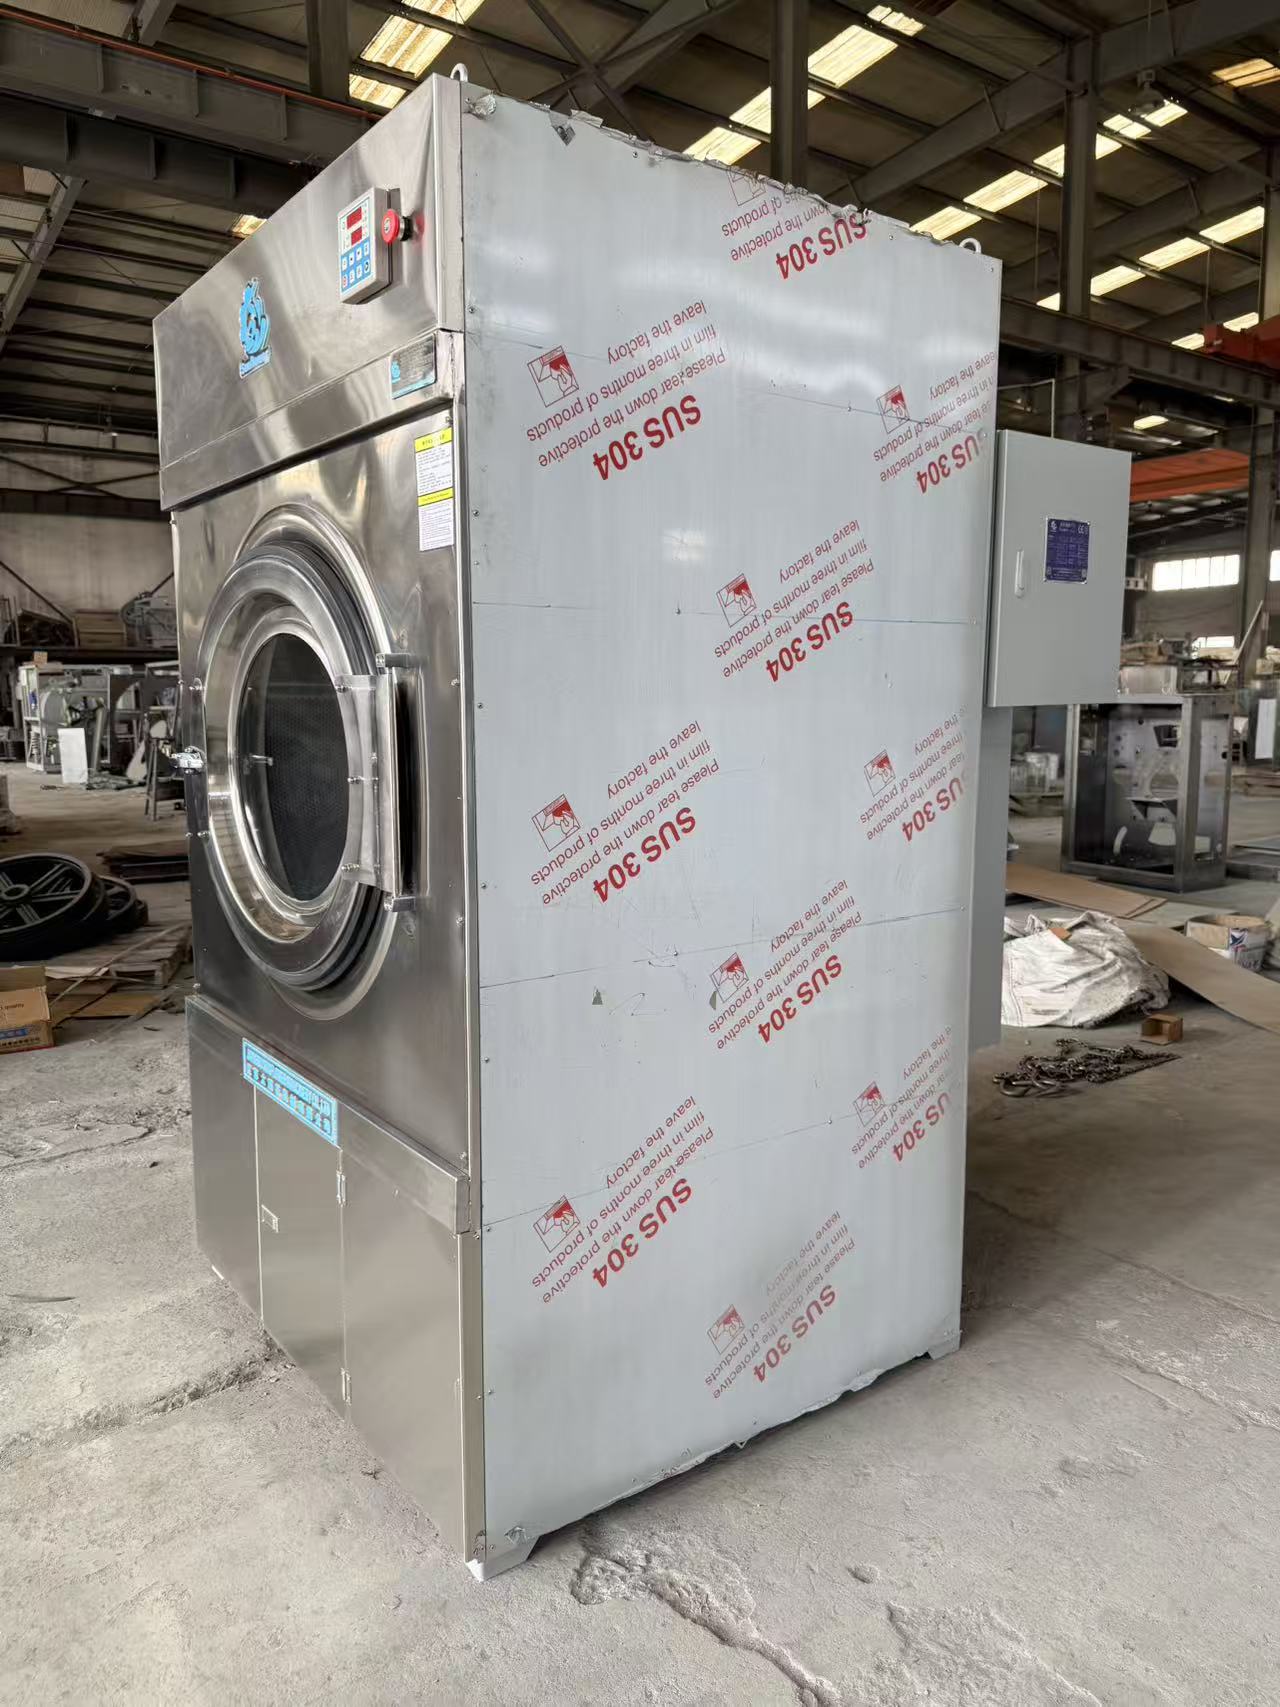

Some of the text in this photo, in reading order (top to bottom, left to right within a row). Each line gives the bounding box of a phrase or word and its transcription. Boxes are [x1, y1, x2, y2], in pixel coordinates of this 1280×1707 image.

[721, 200, 769, 236] products
[731, 199, 831, 260] own the protective
[771, 197, 782, 215] of
[775, 236, 817, 280] 304
[607, 299, 706, 364] leave the factory
[526, 323, 716, 441] film in three months of products
[930, 375, 959, 400] factory
[960, 365, 974, 380] the
[538, 347, 726, 467] Please tear down the protective
[914, 422, 923, 438] of
[939, 420, 962, 441] down
[592, 395, 701, 481] SUS 304
[873, 426, 912, 461] products
[880, 443, 923, 481] protective
[924, 436, 939, 452] the
[916, 453, 950, 494] 304
[780, 518, 859, 584] leave the factory
[714, 538, 867, 657] film in three months of products
[723, 557, 874, 677] Please tear down the protective
[765, 601, 853, 683] SUS 304
[607, 720, 701, 799] leave the factory
[909, 751, 940, 782] months
[915, 726, 943, 756] factory
[860, 784, 898, 823] products
[899, 778, 908, 793] of
[910, 787, 924, 803] the
[924, 766, 947, 790] down
[531, 739, 710, 885] film in three months of products
[542, 758, 719, 904] Please tear down the protective
[867, 797, 909, 840] protective
[902, 800, 935, 842] 304
[593, 807, 696, 903] SUS 304
[771, 878, 847, 953] leave the factory
[708, 894, 854, 1032] film in three months of products
[717, 910, 861, 1049] Please tear down the protective
[757, 954, 842, 1043] SUS 304
[606, 1095, 696, 1189] leave the factory
[532, 1111, 704, 1287] film in three months of products
[543, 1126, 713, 1303] Please tear down the protective
[592, 1178, 692, 1288] SUS 304
[824, 1237, 855, 1273] Please
[830, 1224, 848, 1244] film
[749, 1323, 759, 1339] of
[753, 1284, 835, 1383] SUS 304
[705, 1333, 748, 1385] products
[713, 1341, 760, 1398] protective
